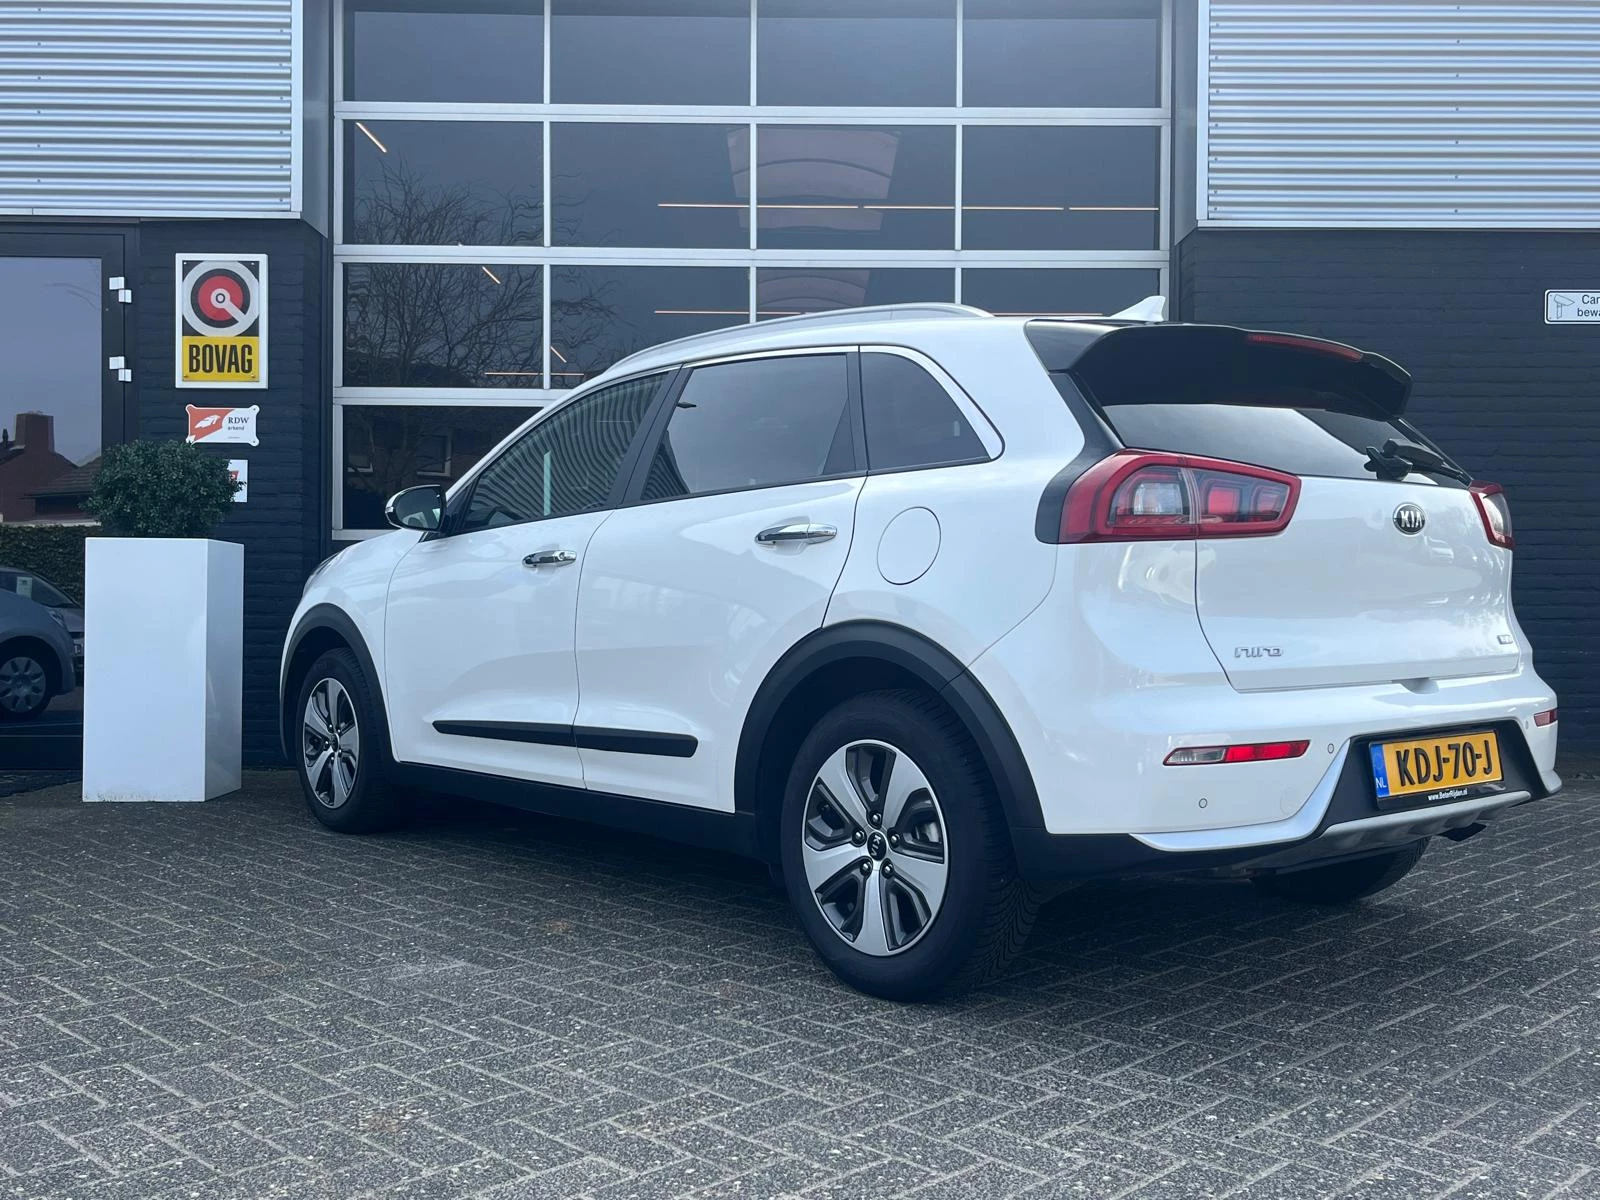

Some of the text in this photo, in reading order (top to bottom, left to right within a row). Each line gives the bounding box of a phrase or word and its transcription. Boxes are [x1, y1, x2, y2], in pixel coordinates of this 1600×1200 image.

[1577, 307, 1600, 317] bew
[188, 344, 253, 373] BOVAG
[228, 416, 249, 424] RDW
[1400, 510, 1423, 528] KIA
[1396, 740, 1493, 787] KDJ-70-J
[1376, 777, 1387, 789] NL
